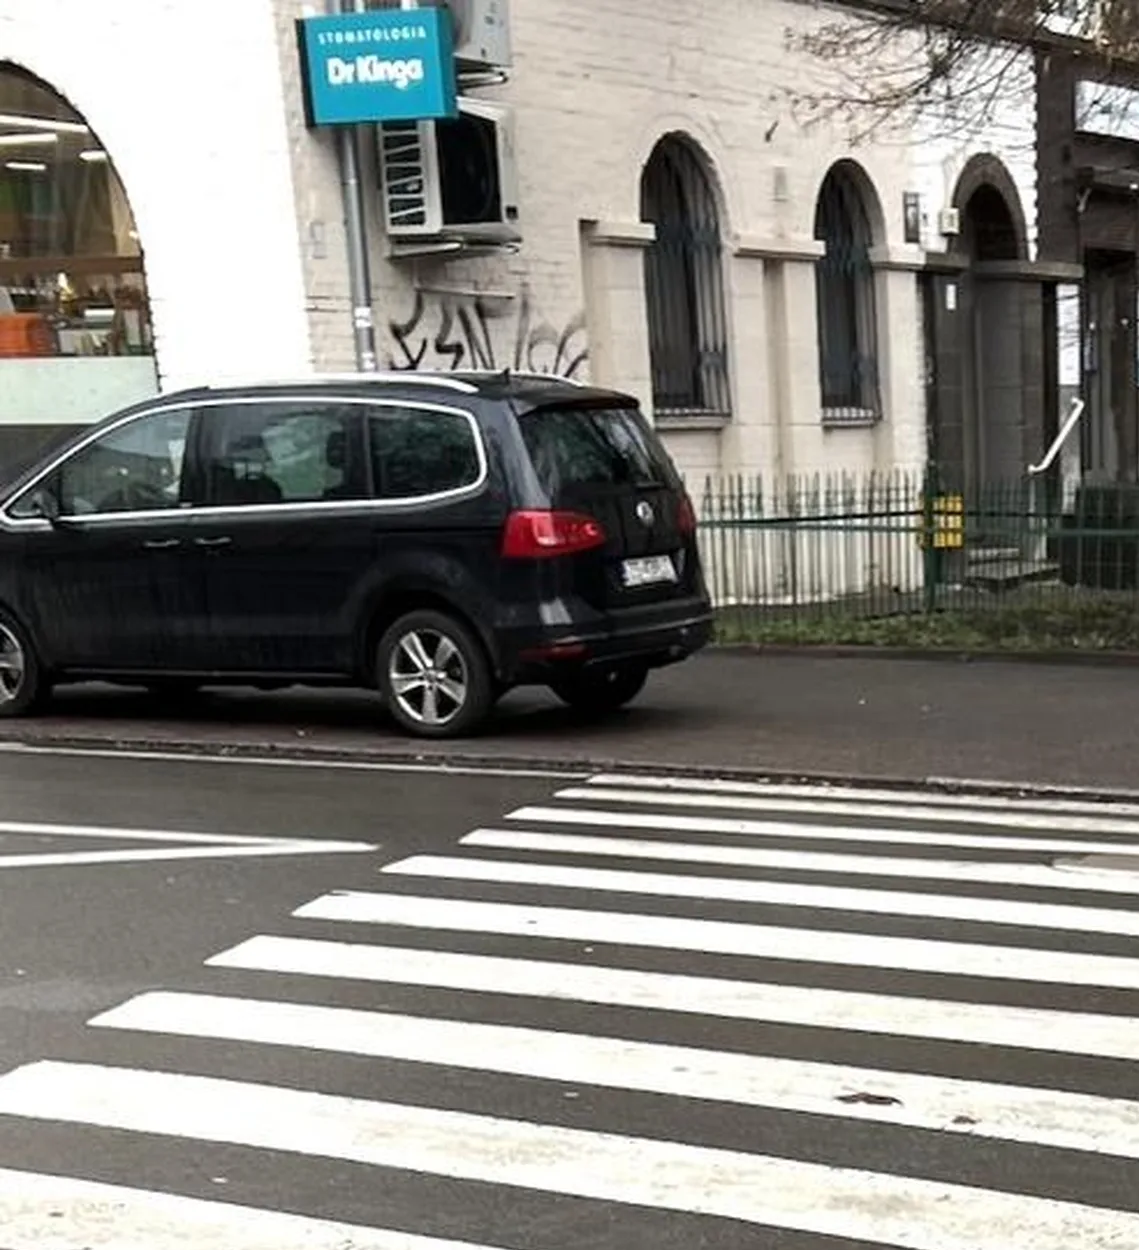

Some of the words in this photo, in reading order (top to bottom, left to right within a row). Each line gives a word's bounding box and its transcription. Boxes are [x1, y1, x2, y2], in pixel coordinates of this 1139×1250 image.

[317, 25, 427, 45] STOMATOLOGIA
[327, 57, 355, 85] Dr
[355, 55, 424, 90] Kinga
